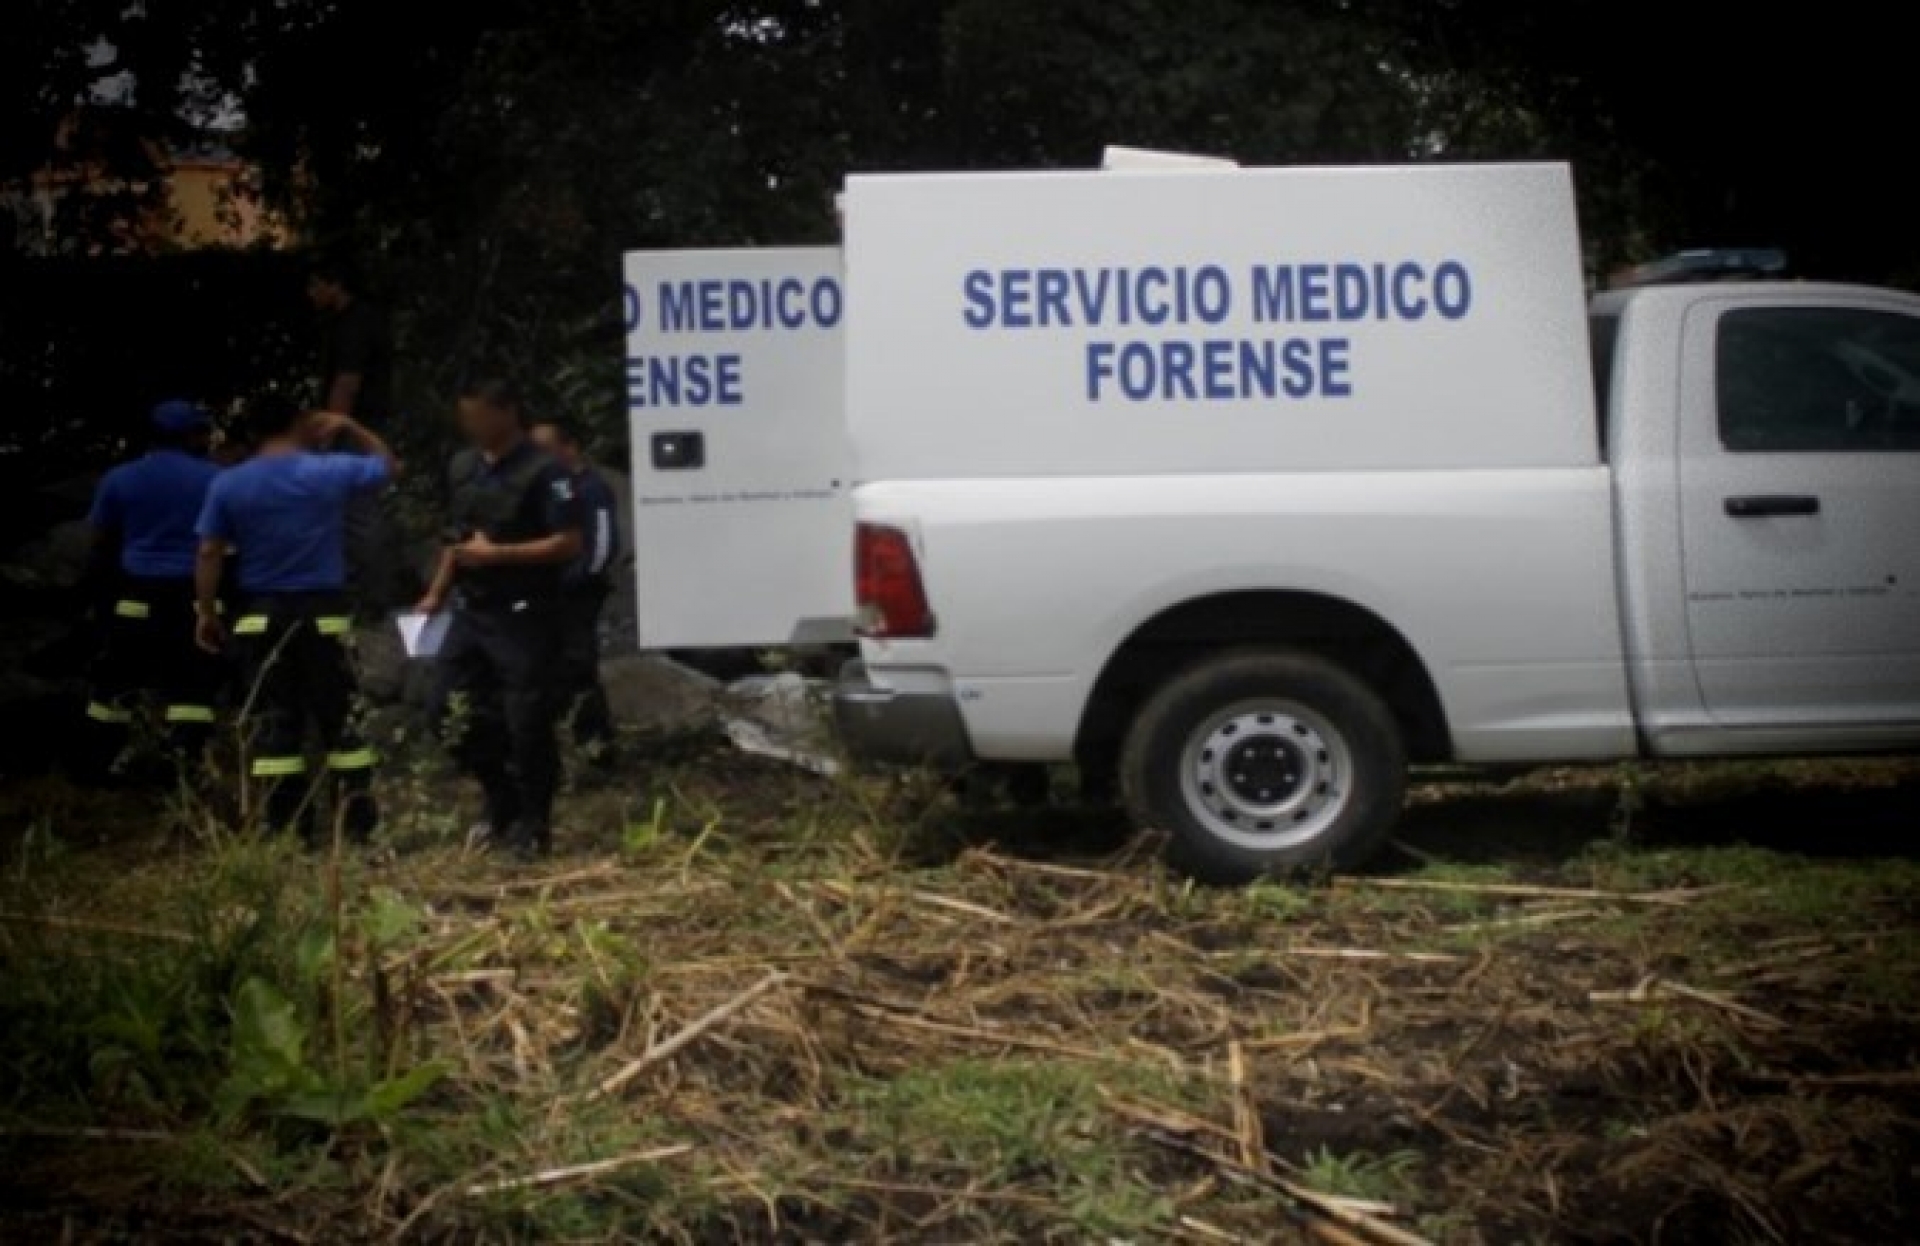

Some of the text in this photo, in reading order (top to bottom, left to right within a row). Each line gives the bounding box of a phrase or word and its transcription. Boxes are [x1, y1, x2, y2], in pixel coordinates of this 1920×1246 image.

[658, 277, 842, 332] MEDICO
[964, 261, 1471, 328] SERVICIO MEDICO
[626, 354, 743, 407] ENSE
[1087, 337, 1351, 400] FORENSE
